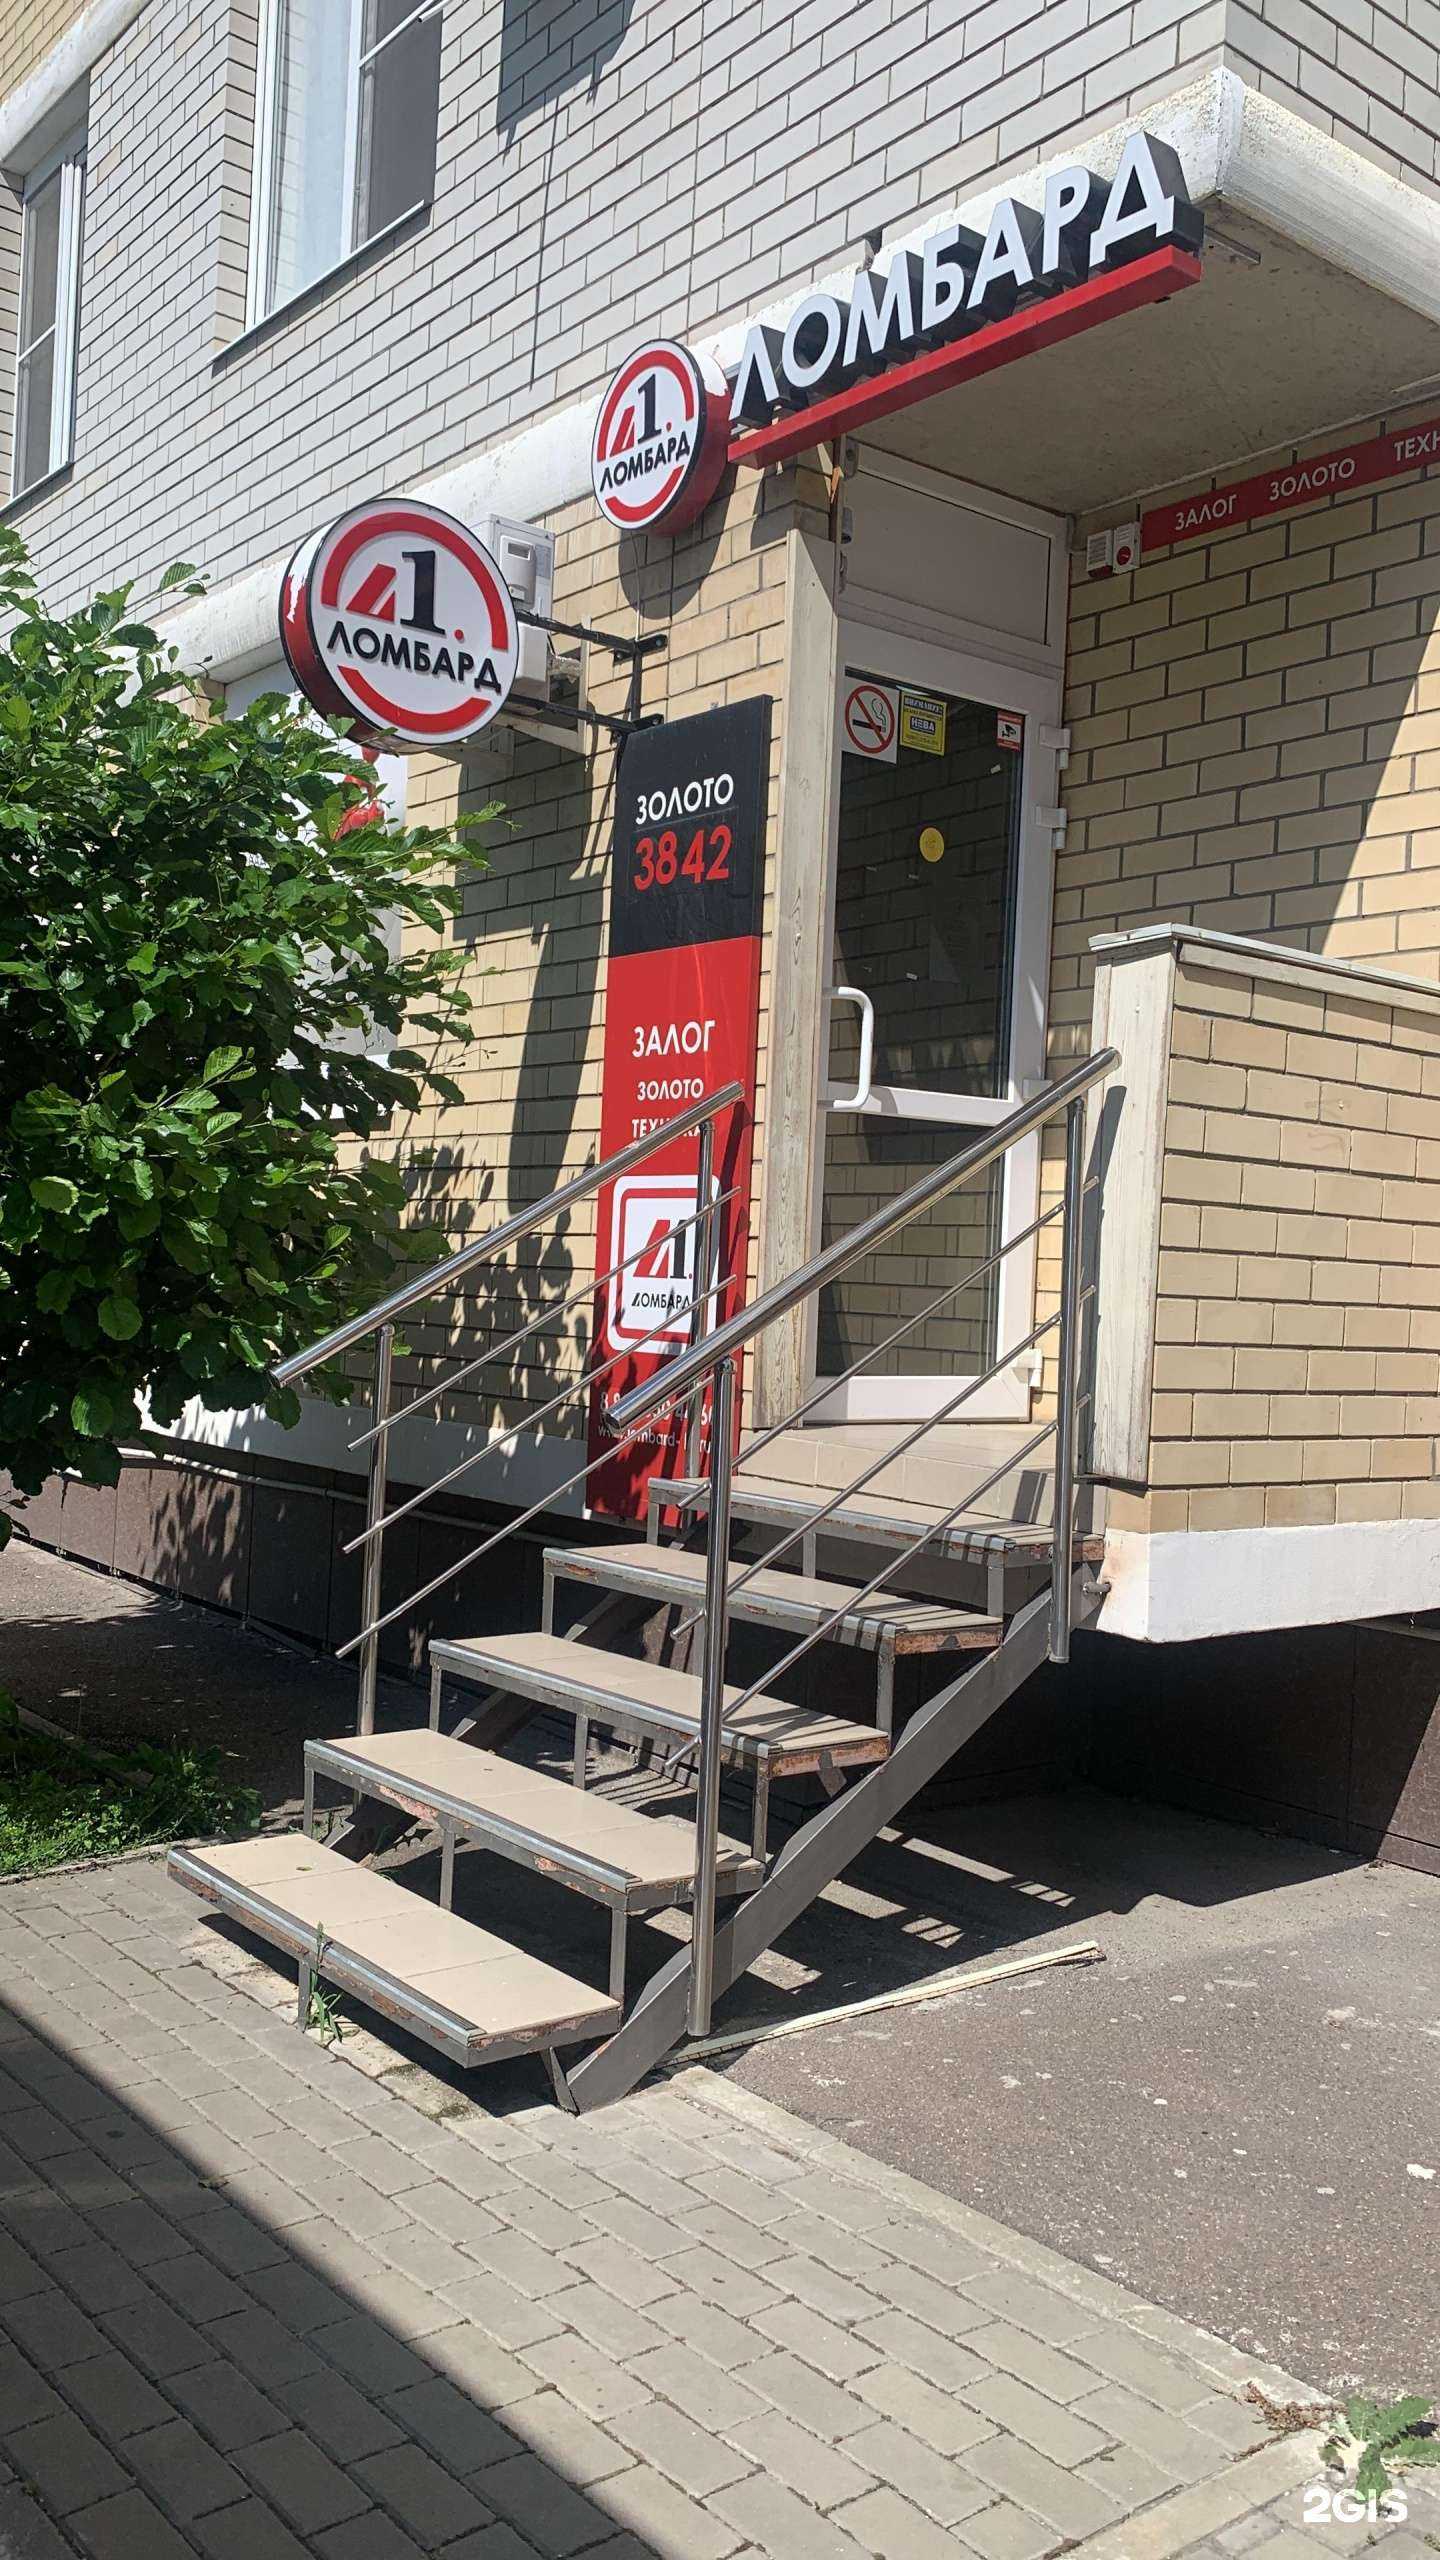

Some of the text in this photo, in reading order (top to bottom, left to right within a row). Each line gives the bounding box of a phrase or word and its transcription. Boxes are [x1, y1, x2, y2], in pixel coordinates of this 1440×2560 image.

[729, 131, 1176, 421] ЛОМБАРД
[600, 430, 690, 492] ЛОМБАРД
[1174, 494, 1237, 531] ЗАЛОГ
[1269, 457, 1356, 501] ЗОЛОТО
[327, 620, 502, 695] ЛОМБАРД
[635, 773, 735, 825] ЗОЛОТО
[633, 824, 733, 891] 3842
[632, 1020, 717, 1058] ЗАЛОГ
[637, 1078, 704, 1101] ЗОЛОТО
